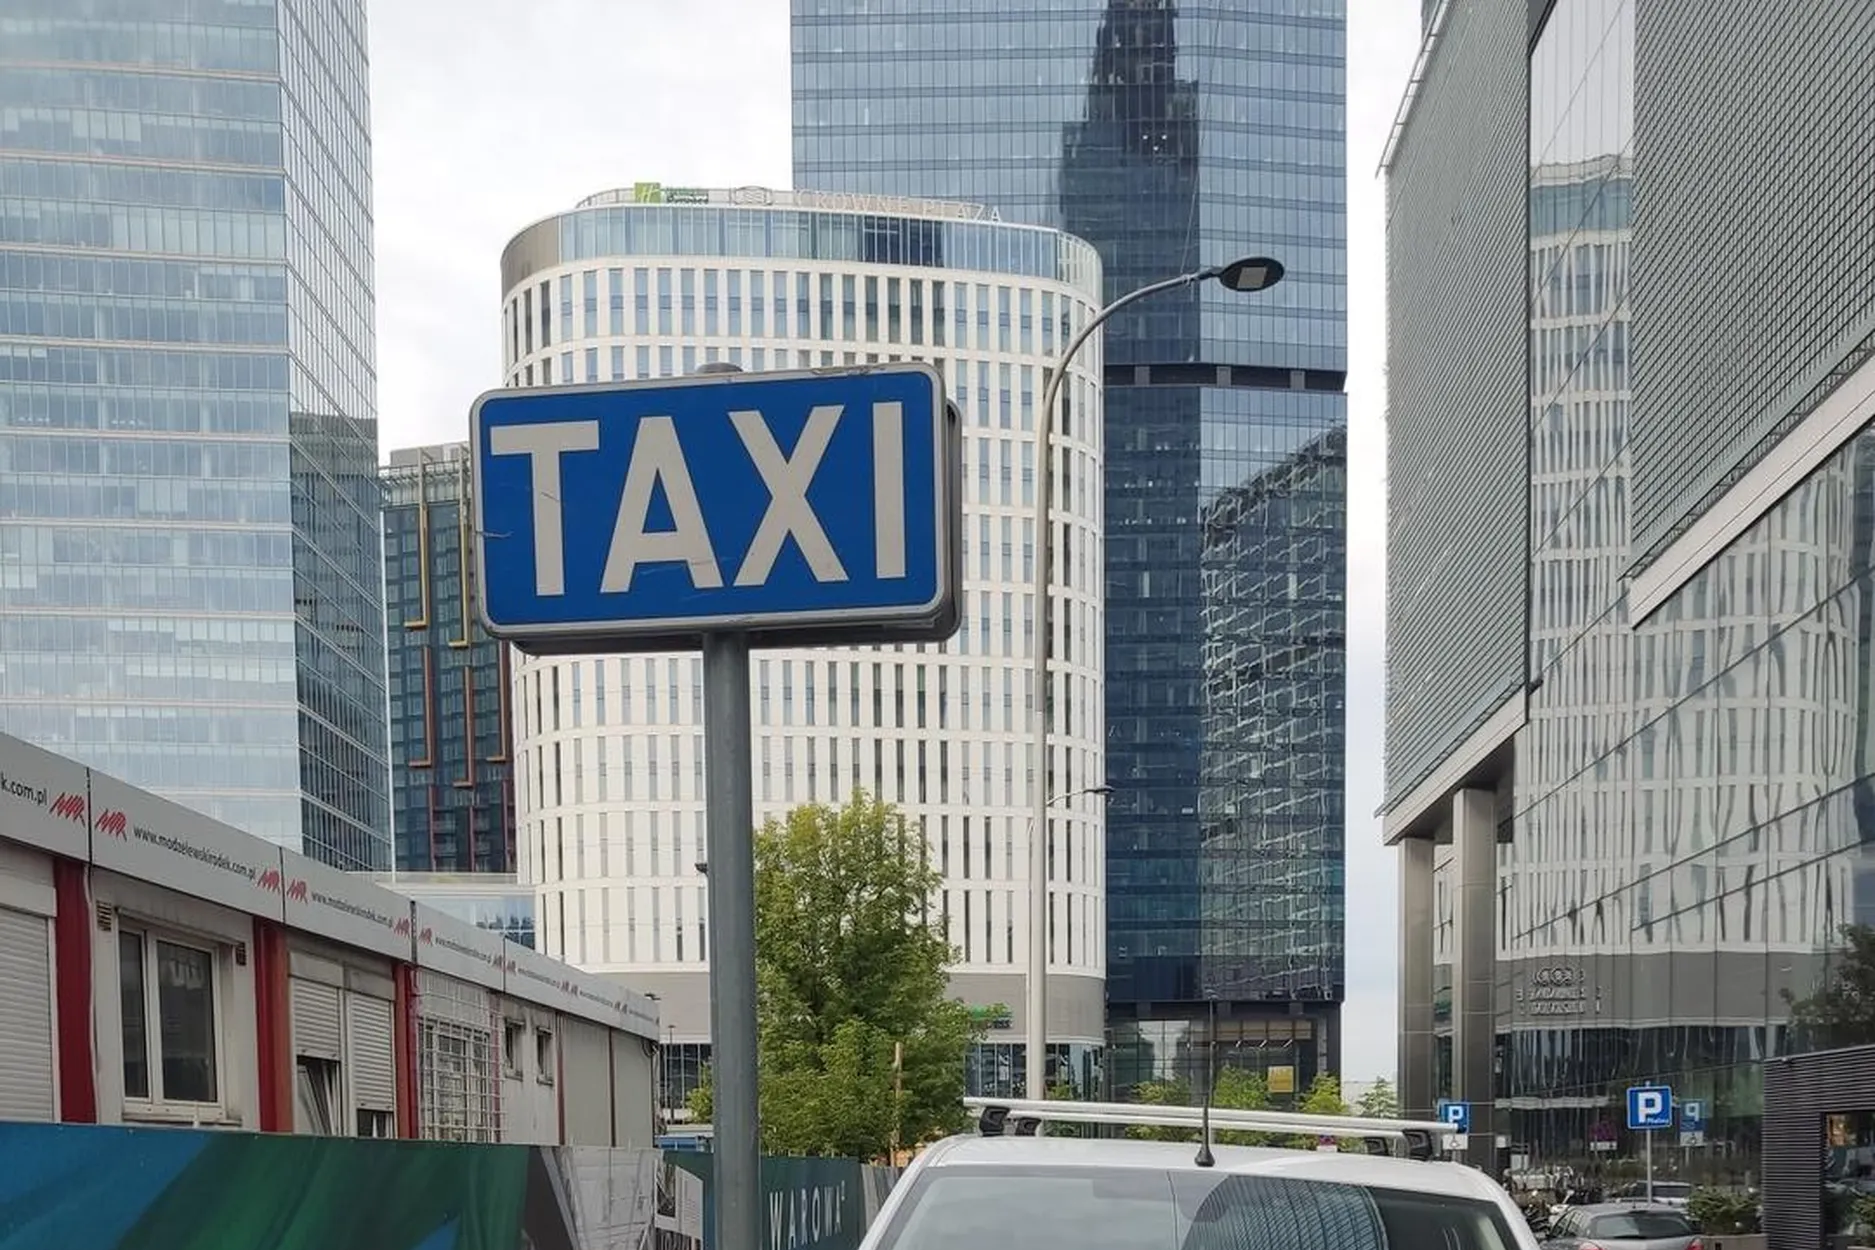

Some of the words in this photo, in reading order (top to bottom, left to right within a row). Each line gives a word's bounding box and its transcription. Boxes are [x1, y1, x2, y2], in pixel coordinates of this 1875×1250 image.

[490, 402, 906, 596] TAXI
[1448, 1106, 1464, 1123] P
[1638, 1092, 1662, 1123] P
